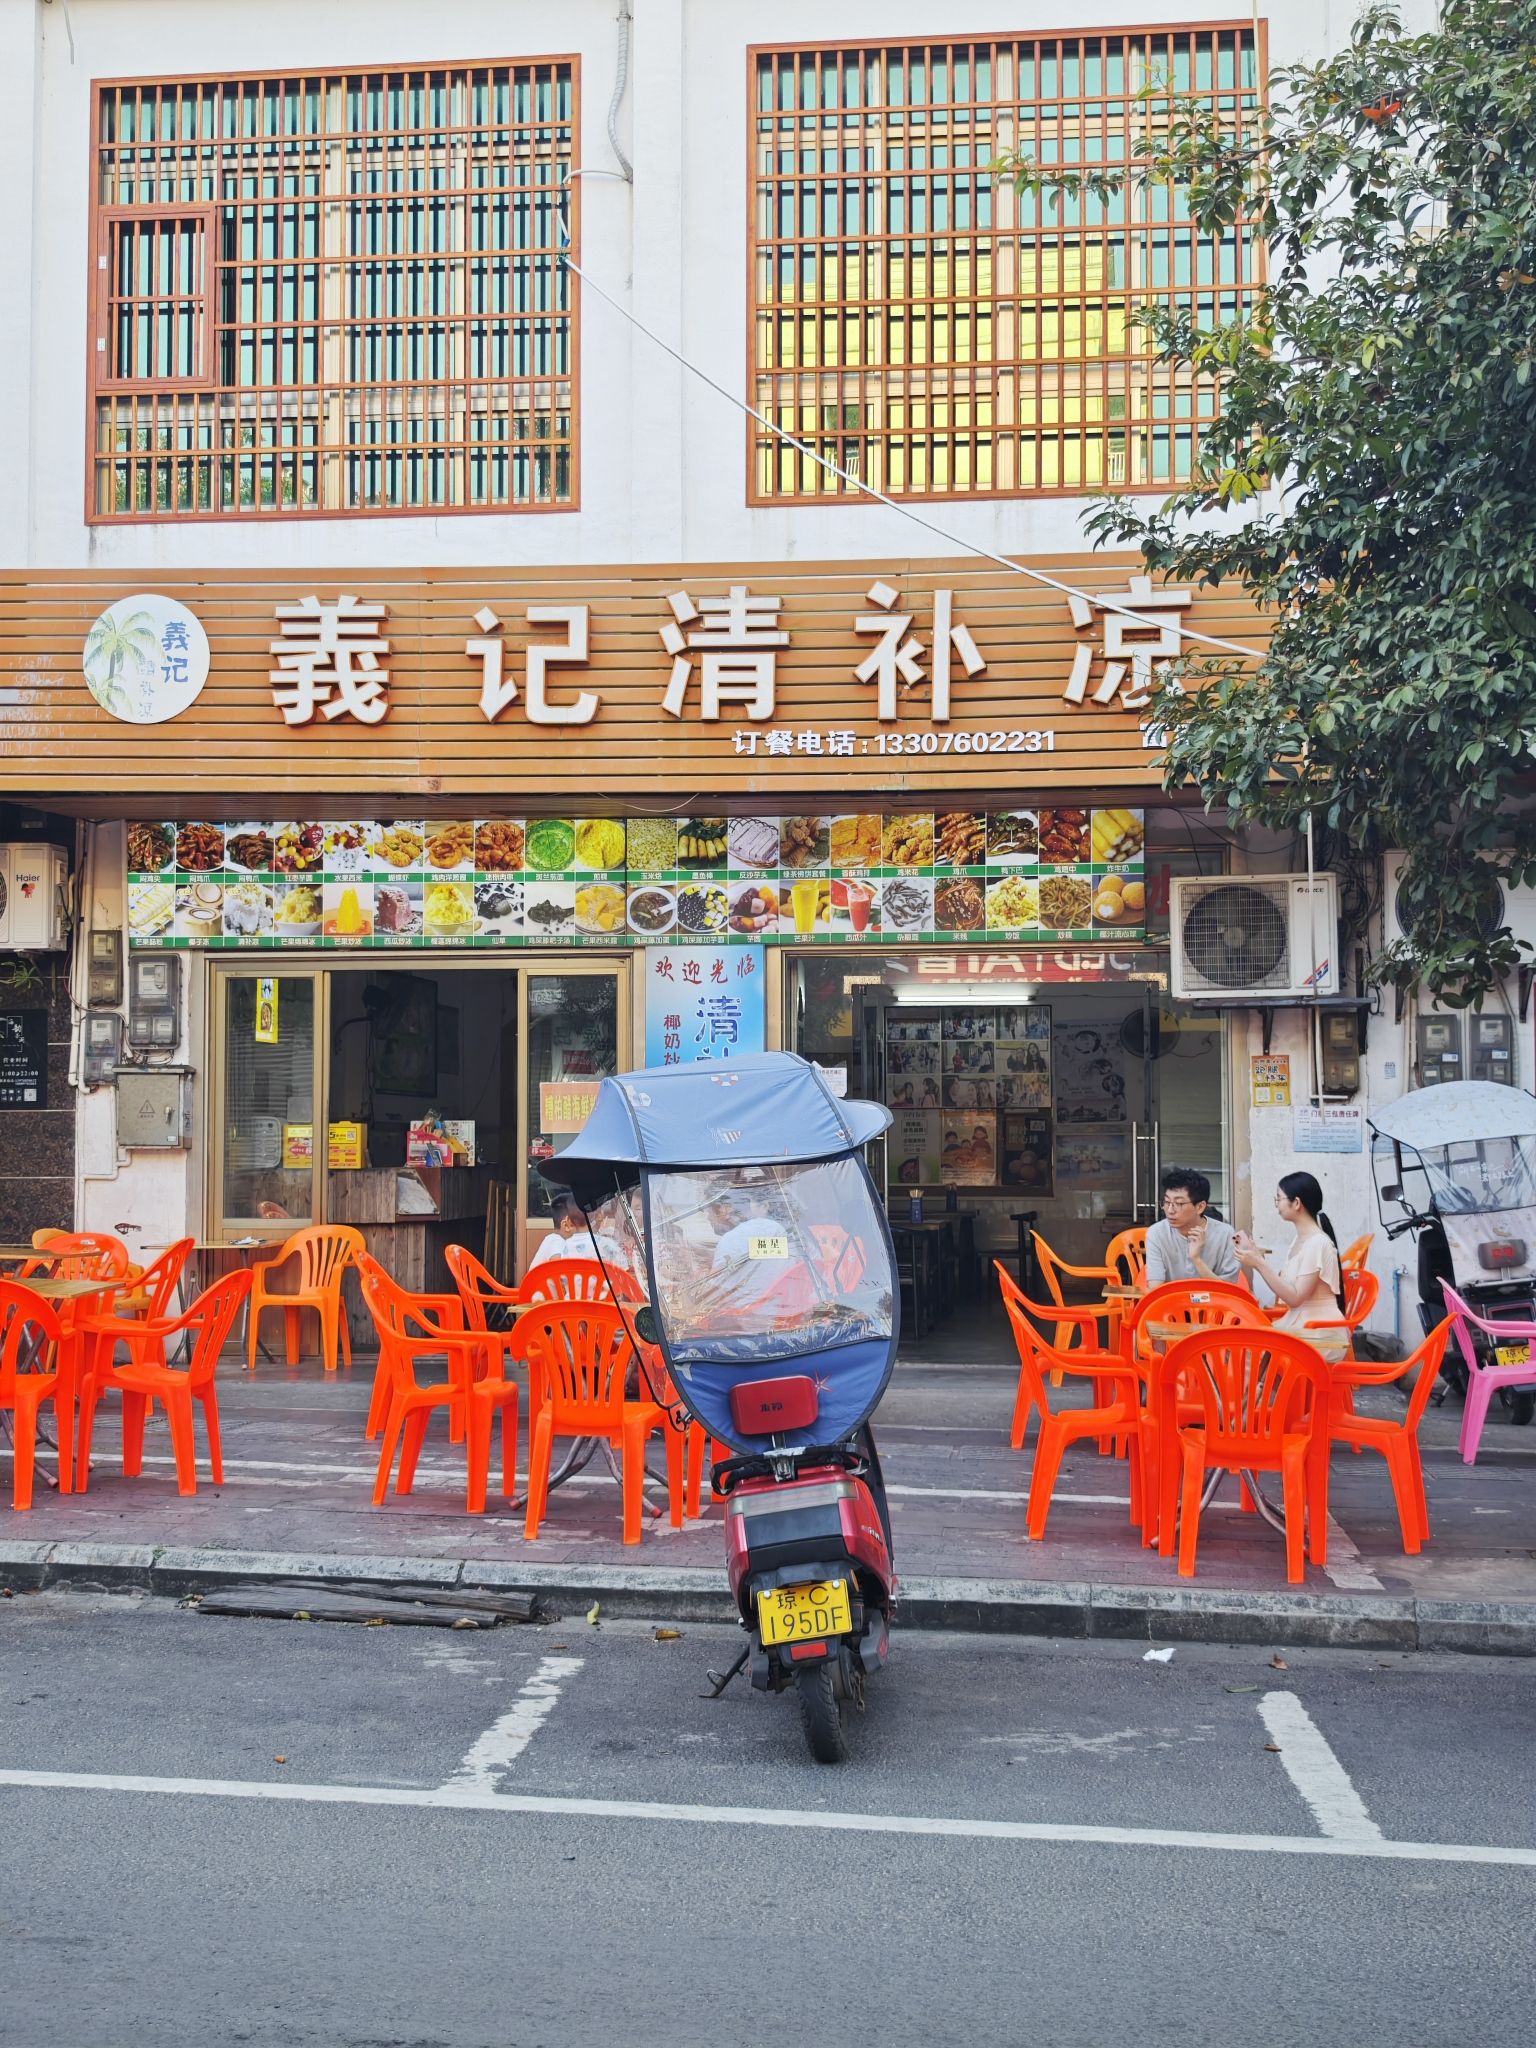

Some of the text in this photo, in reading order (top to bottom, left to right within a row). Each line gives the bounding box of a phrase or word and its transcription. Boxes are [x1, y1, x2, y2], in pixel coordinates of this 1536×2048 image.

[161, 621, 190, 683] 義记
[269, 576, 1191, 725] 義记清补凉
[897, 868, 919, 876] 鸡米花
[953, 868, 967, 876] 鸡爪
[1106, 865, 1129, 873] 炸牛奶
[16, 874, 40, 882] Haier
[431, 873, 466, 881] 鸡肉洋葱圈
[739, 871, 768, 879] 反沙芋头
[746, 935, 761, 943] 芋圆
[793, 935, 815, 943] 芒果汁
[845, 934, 868, 942] 西瓜汁
[1004, 932, 1020, 940] 炒饭
[656, 956, 755, 985] 欢迎光临
[776, 1586, 829, 1610] 琼·C
[771, 1606, 843, 1640] 195DF
